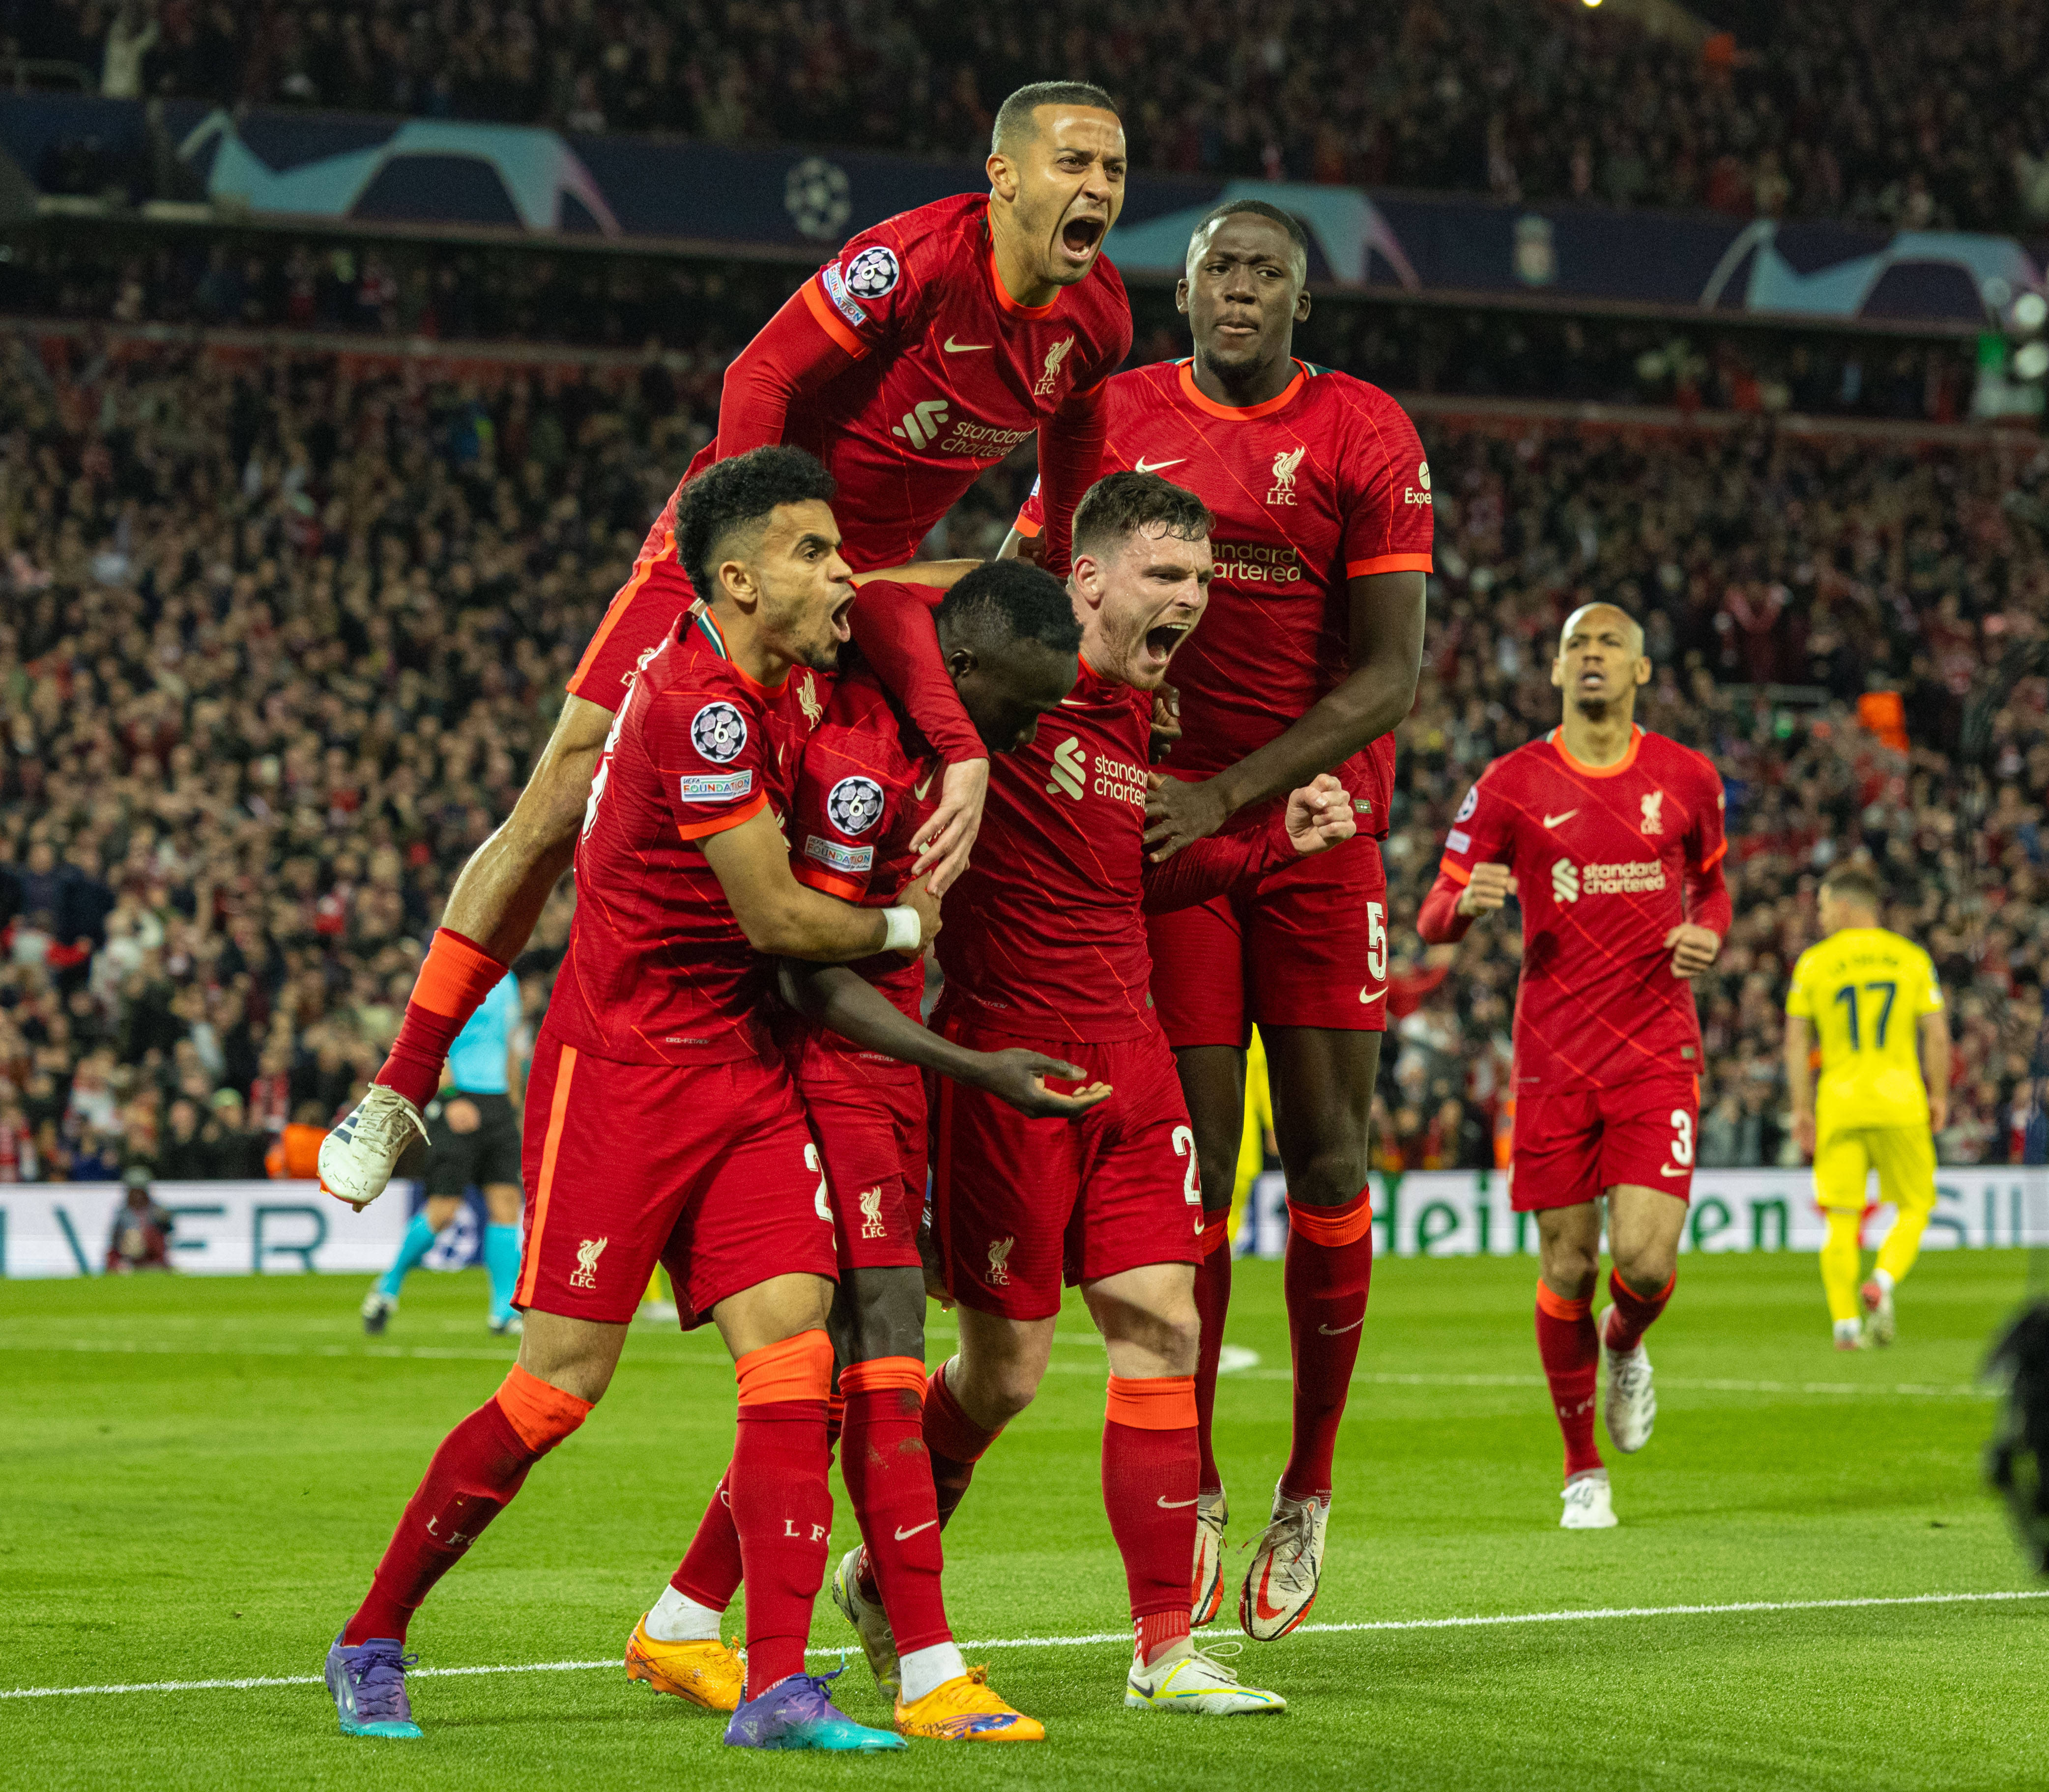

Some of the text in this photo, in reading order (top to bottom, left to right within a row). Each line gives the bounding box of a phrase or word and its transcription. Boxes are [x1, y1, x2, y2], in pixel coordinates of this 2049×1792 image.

[861, 263, 879, 280] 6
[829, 267, 863, 321] FOUNDATION
[1266, 492, 1297, 506] L.F.C.
[1211, 542, 1297, 563] andard
[1213, 560, 1301, 582] artered
[714, 720, 729, 743] 6
[1095, 754, 1148, 788] standar
[684, 778, 750, 793] FOUNDATION
[1094, 776, 1146, 809] charter
[849, 795, 864, 817] 6
[807, 843, 870, 864] FOUNDATION
[1583, 858, 1662, 880] standard
[1583, 873, 1666, 894] chartered
[1366, 902, 1386, 981] 5
[1834, 981, 1897, 1051] 17
[1671, 1109, 1693, 1166] 3
[862, 1226, 887, 1238] L.F.C.
[570, 1274, 596, 1289] L.F.C.
